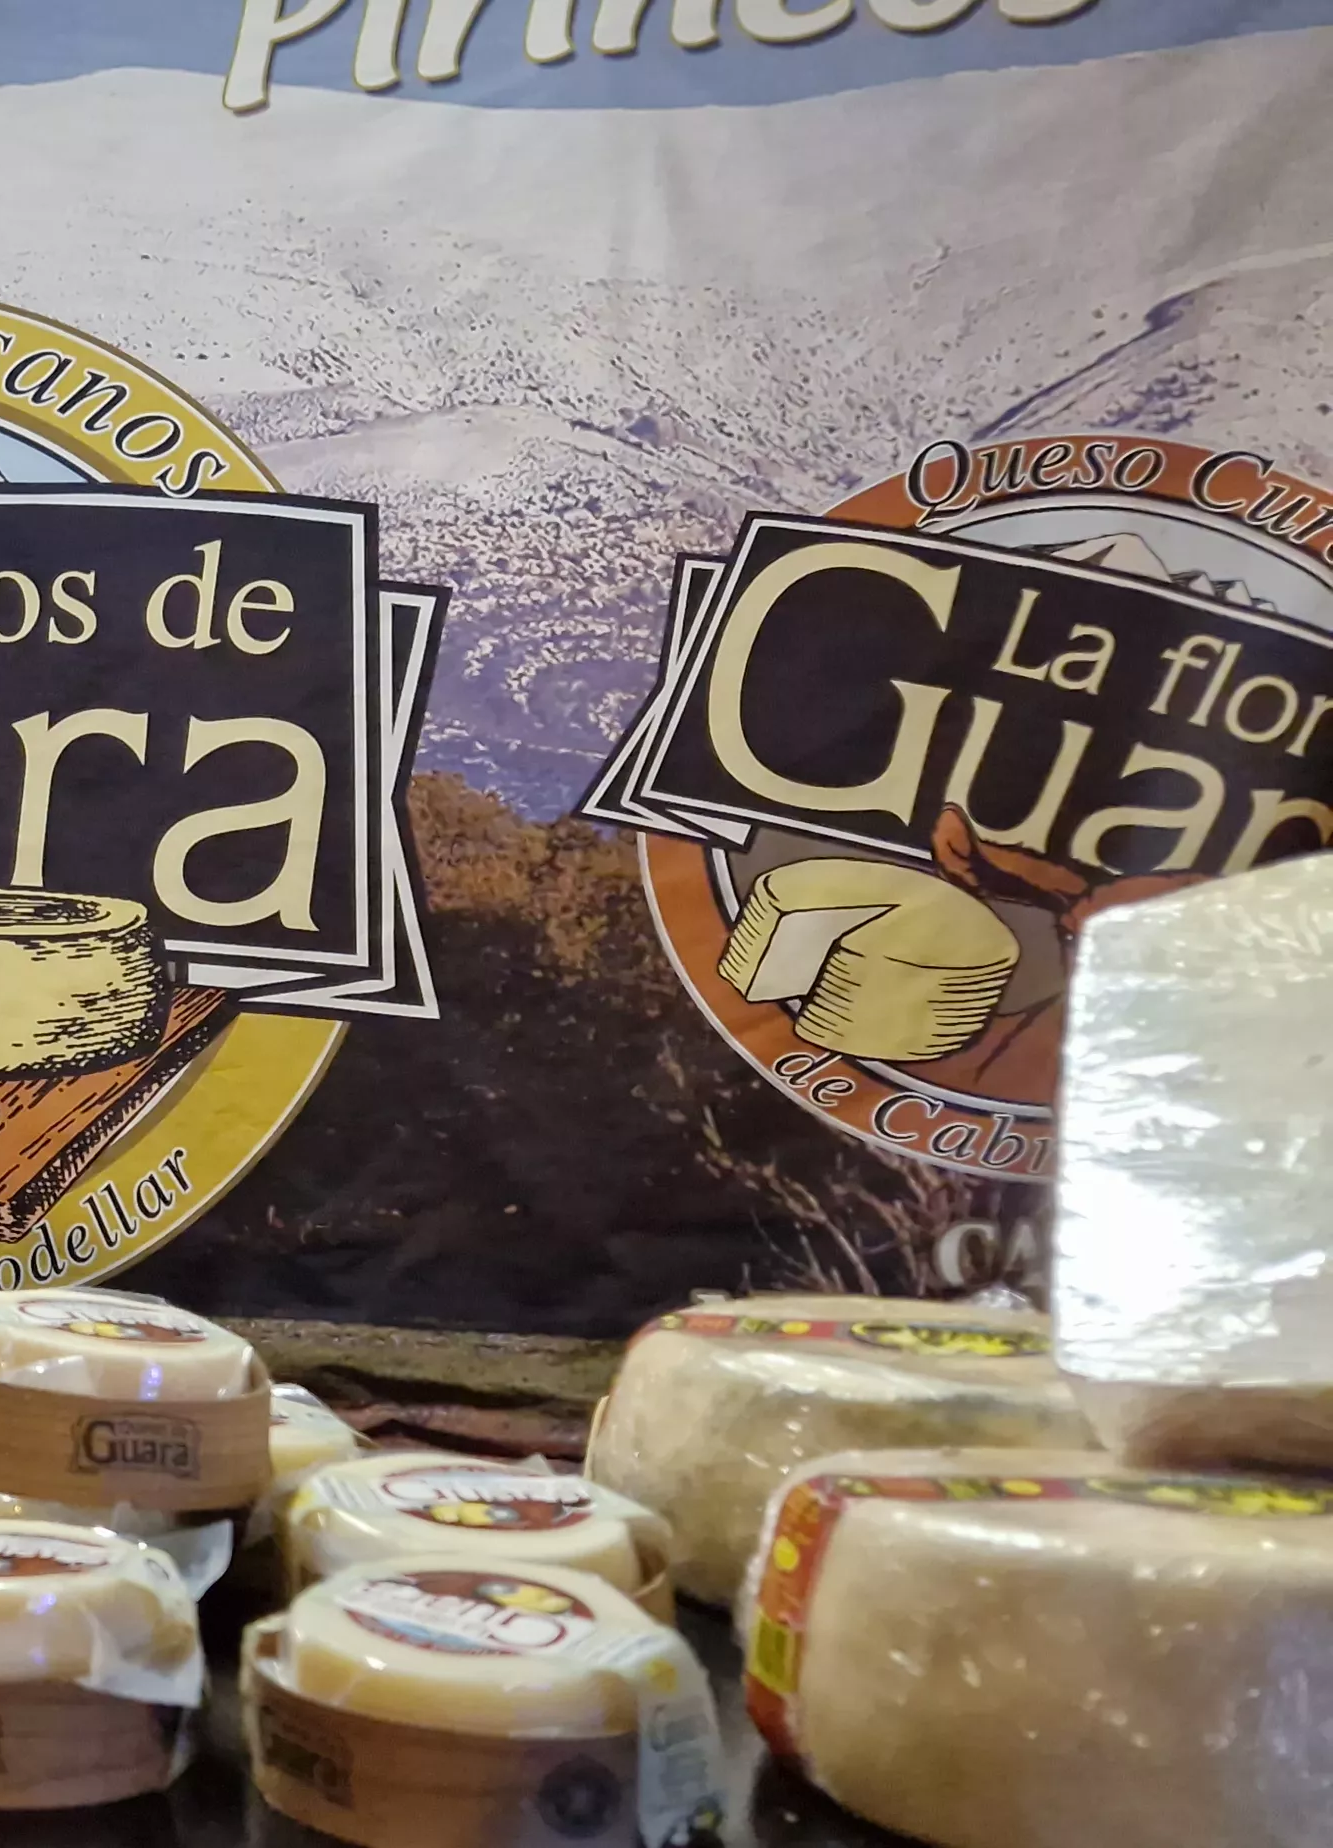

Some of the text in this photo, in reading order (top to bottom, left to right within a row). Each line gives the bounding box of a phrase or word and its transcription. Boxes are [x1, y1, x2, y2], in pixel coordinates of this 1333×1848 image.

[906, 440, 1333, 564] Queso Cur
[145, 539, 293, 655] de
[993, 588, 1116, 697] La
[773, 1052, 856, 1106] de
[83, 1420, 189, 1467] Guara
